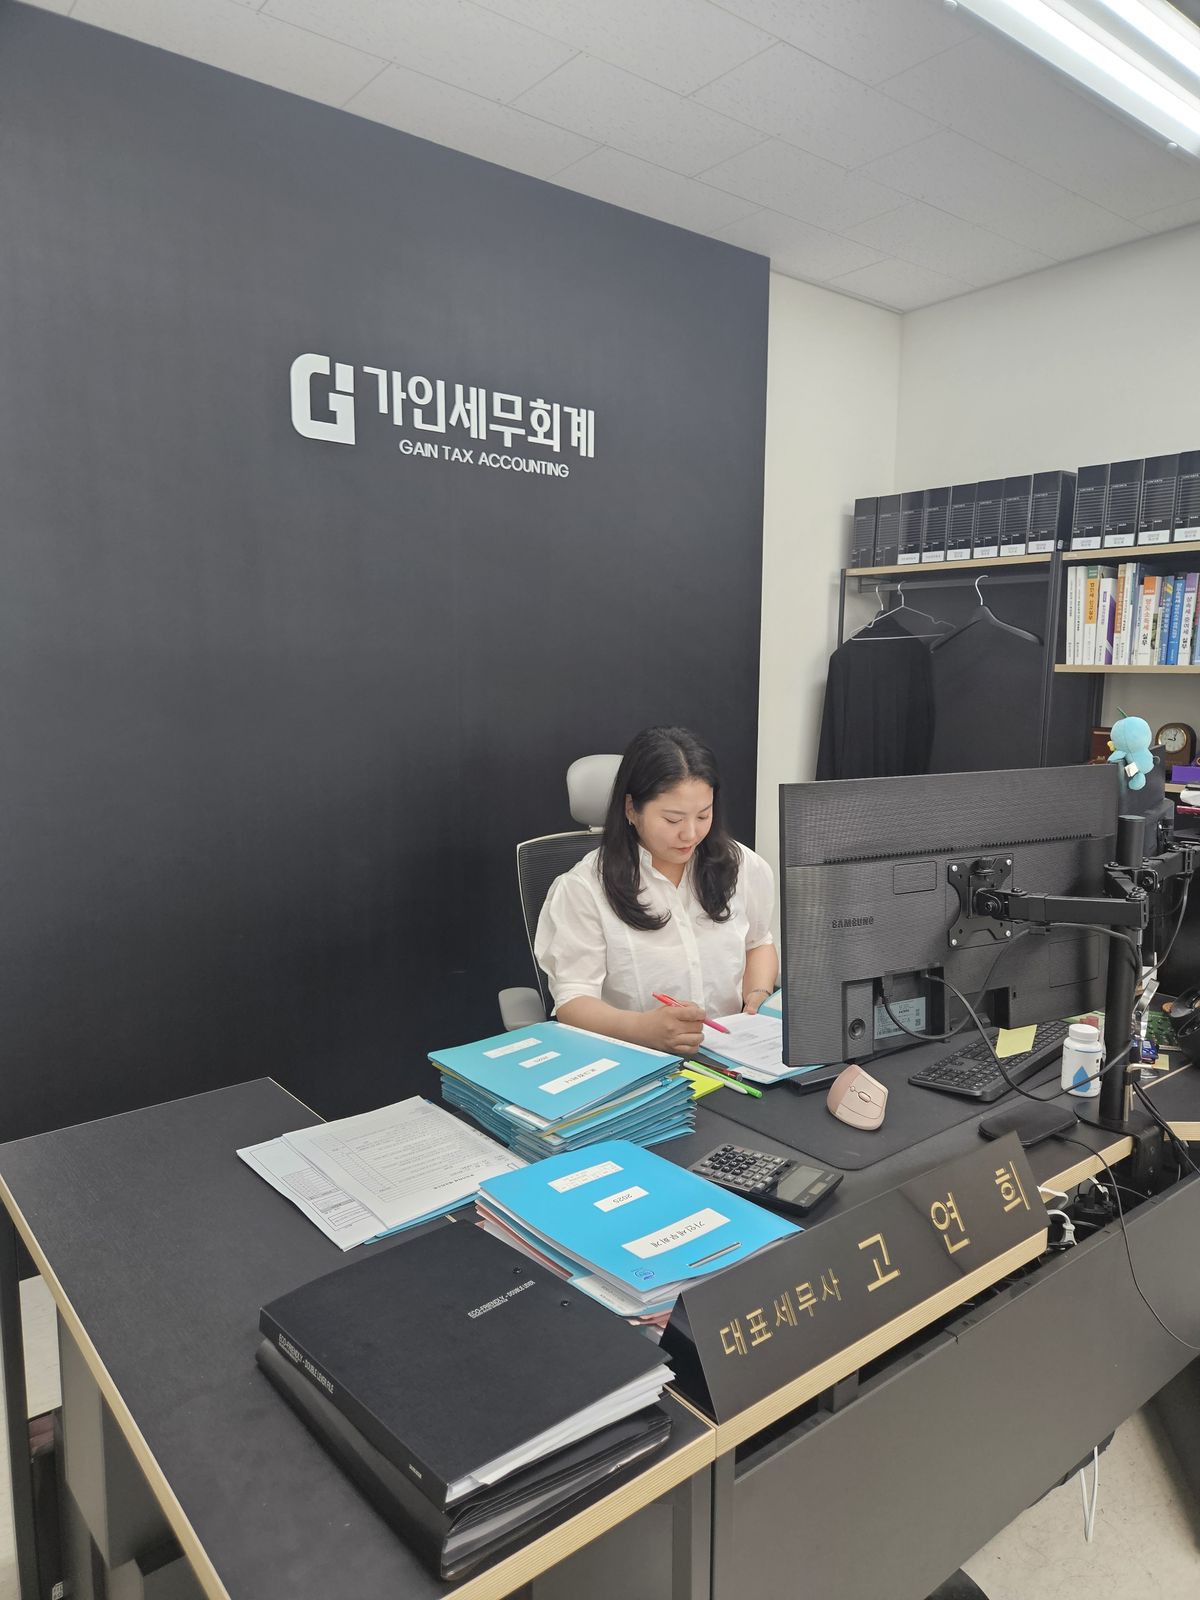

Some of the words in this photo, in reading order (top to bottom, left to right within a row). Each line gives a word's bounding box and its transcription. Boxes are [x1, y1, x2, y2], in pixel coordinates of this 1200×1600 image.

[363, 365, 595, 458] 가인세무회계
[399, 439, 438, 460] GAIN
[442, 445, 474, 465] TAX
[478, 451, 570, 478] ACCOUNTING
[831, 916, 875, 929] SAMSUNG
[718, 1267, 843, 1356] 대표세무사
